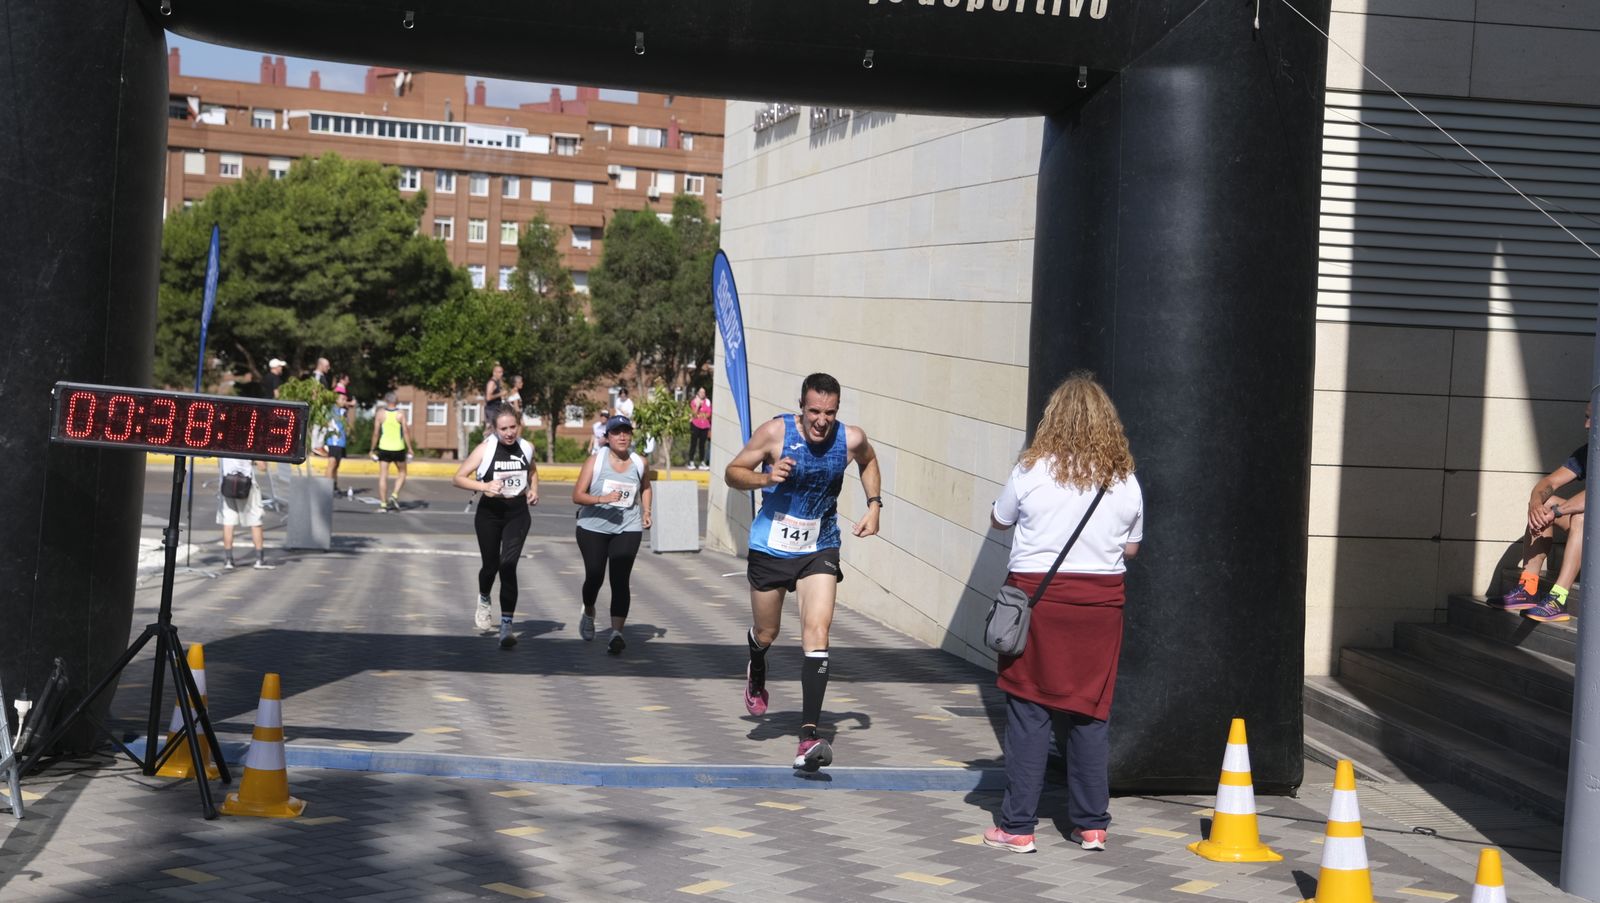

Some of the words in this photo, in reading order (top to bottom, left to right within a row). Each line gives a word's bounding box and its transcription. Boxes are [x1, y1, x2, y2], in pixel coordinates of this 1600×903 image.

[918, 0, 1108, 19] ortivo
[66, 392, 295, 454] 00:38:13
[494, 461, 522, 470] PUMA
[781, 527, 809, 541] 141
